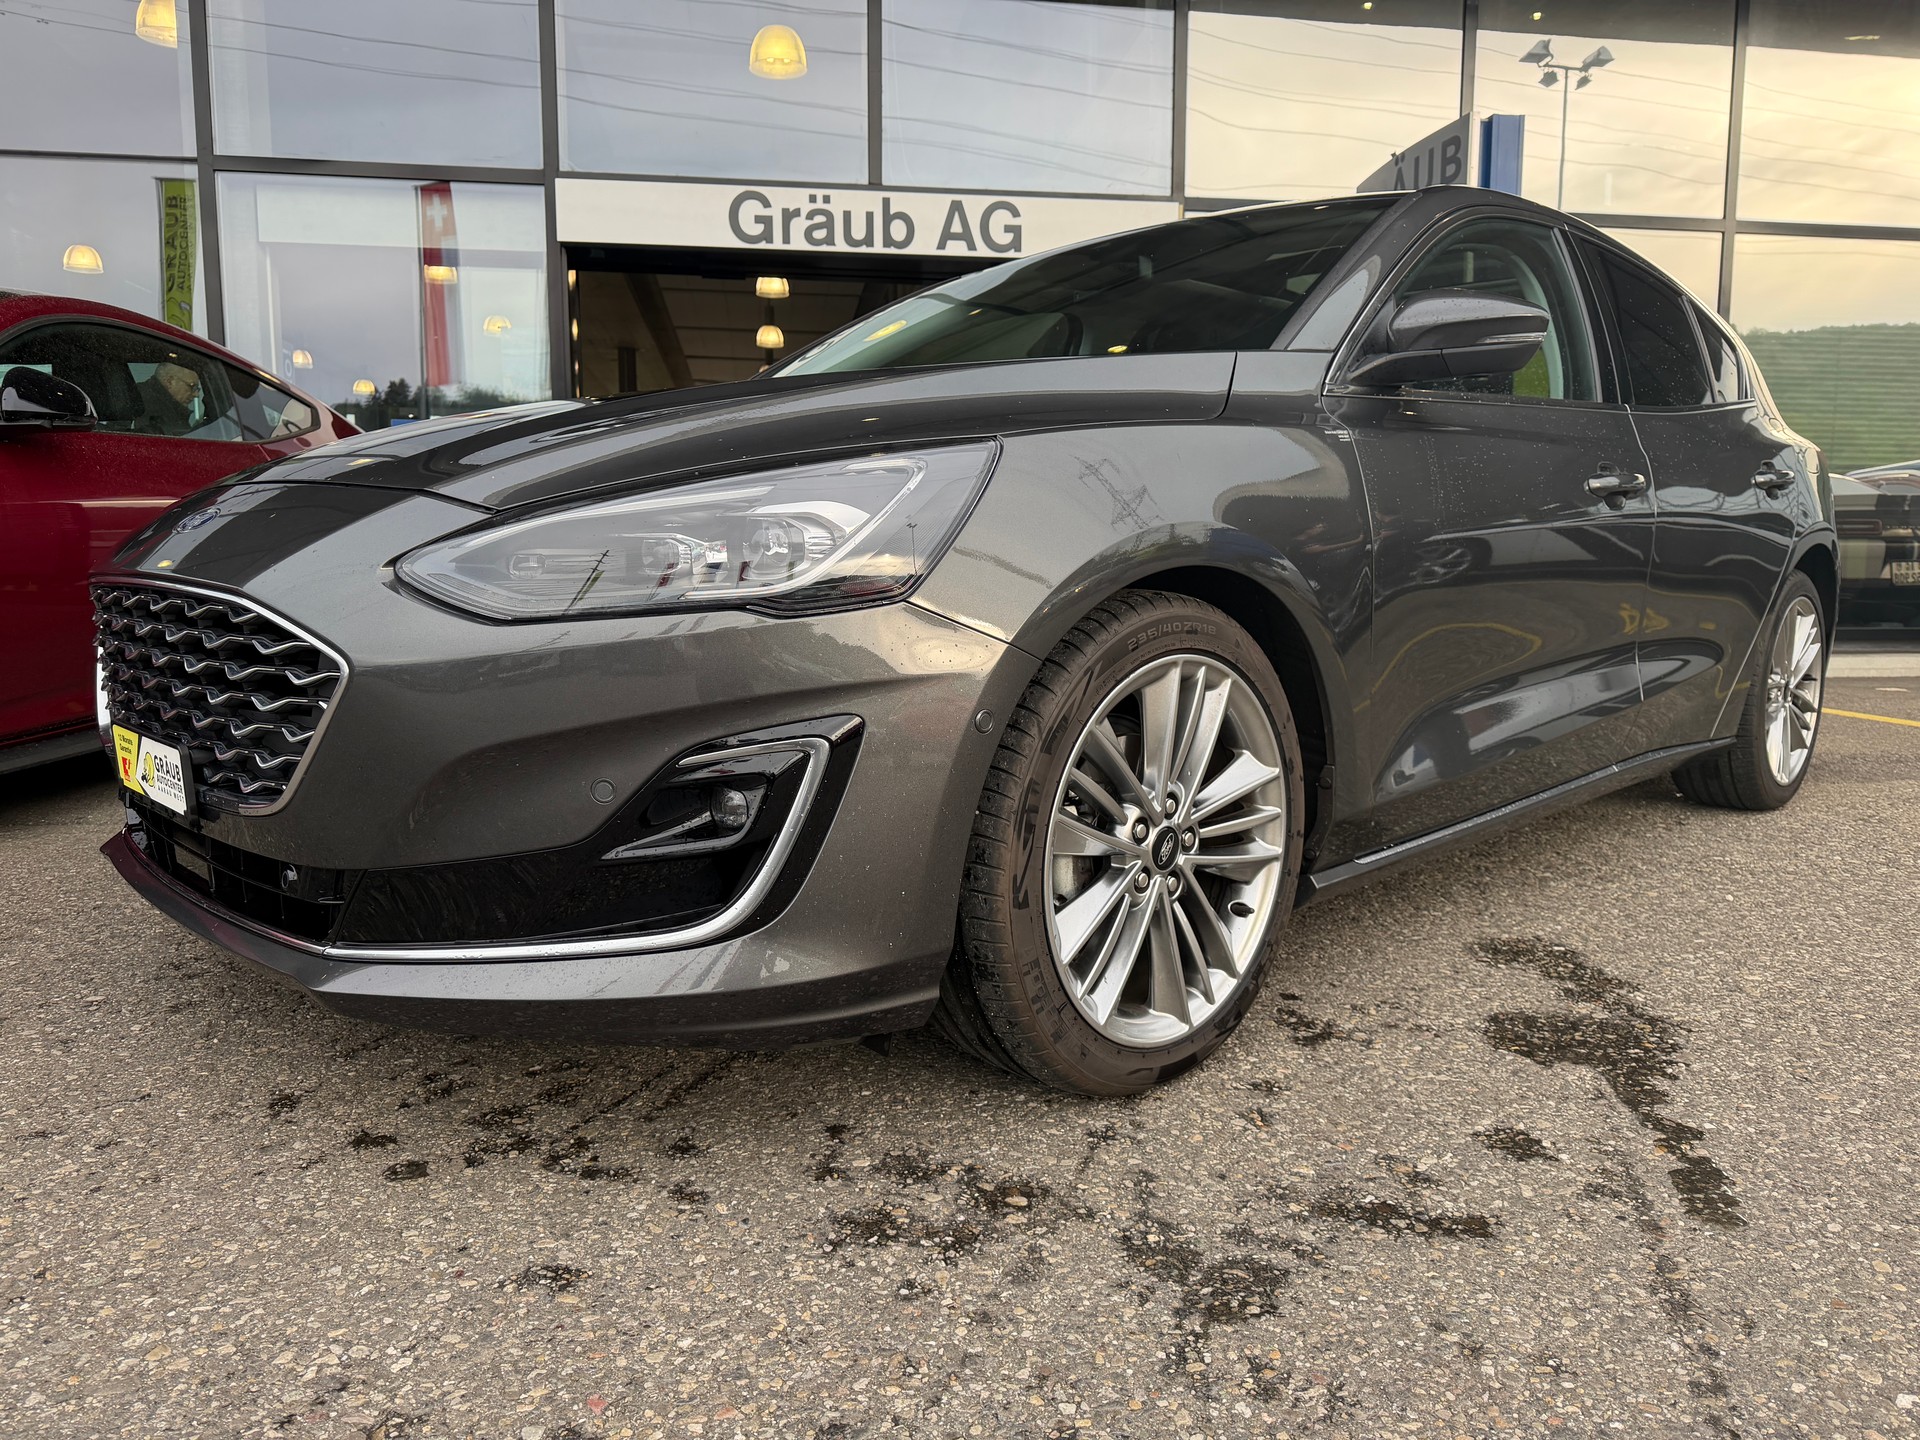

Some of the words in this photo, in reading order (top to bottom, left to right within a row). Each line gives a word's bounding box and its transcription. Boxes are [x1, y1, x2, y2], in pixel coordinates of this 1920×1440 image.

[177, 196, 189, 291] AUTOCENTER
[728, 190, 915, 249] Gräub
[936, 199, 1022, 253] AG
[154, 754, 181, 782] GRÄUB
[156, 774, 184, 795] AUTOCENTER
